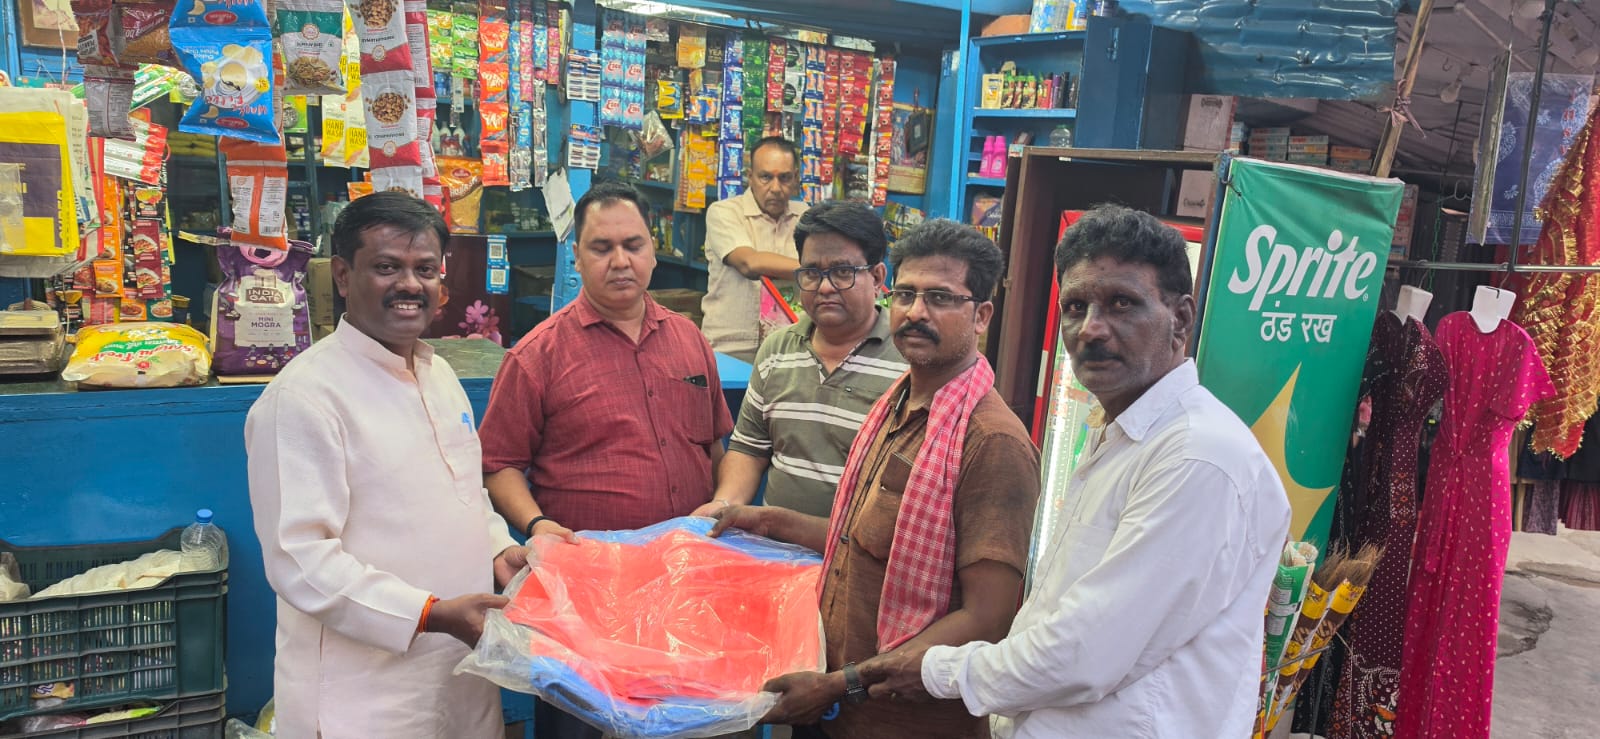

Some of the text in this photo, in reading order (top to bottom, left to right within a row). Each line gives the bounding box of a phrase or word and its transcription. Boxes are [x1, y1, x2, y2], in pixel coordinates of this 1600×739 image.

[1228, 224, 1377, 311] Sprite
[248, 289, 281, 297] INDIA
[1260, 300, 1338, 342] ठंड रख
